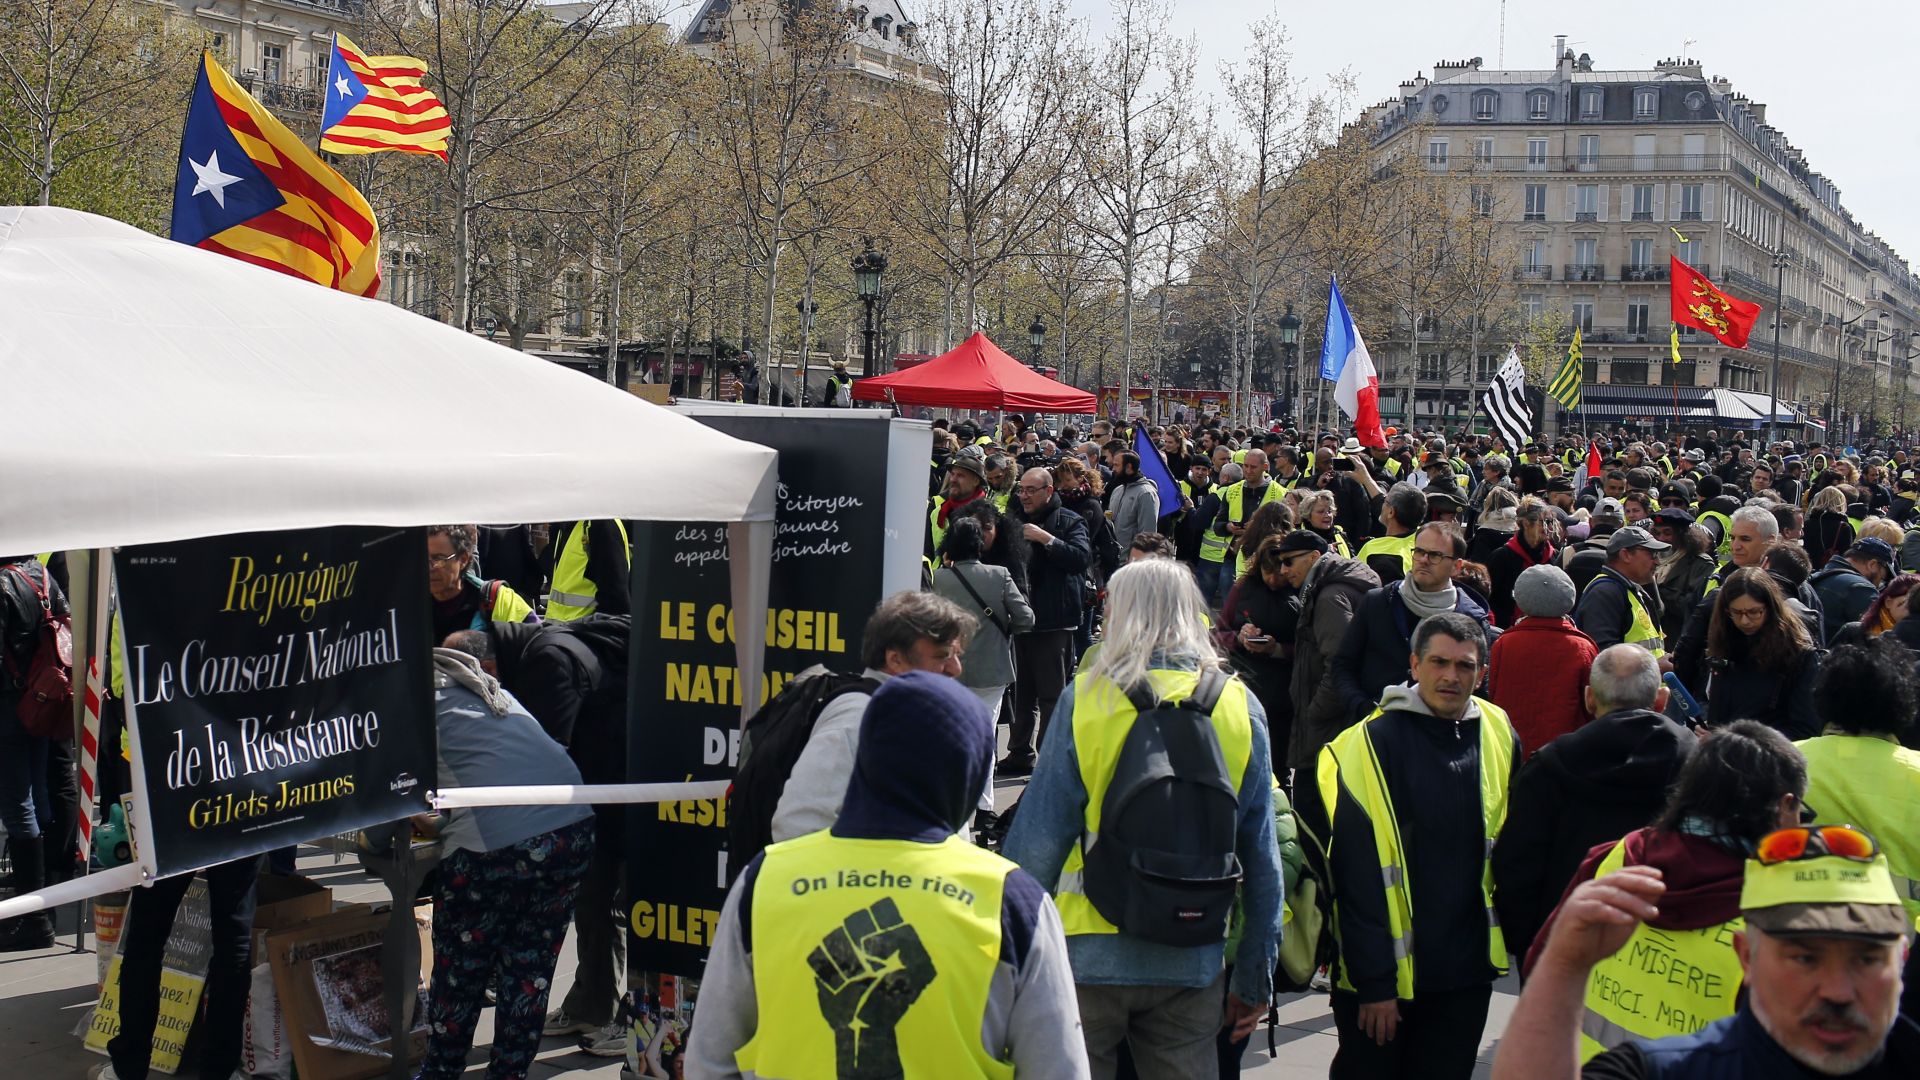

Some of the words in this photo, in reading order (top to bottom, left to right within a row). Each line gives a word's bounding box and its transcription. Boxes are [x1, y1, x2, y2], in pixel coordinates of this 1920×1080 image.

[786, 495, 863, 514] citoyen
[675, 525, 707, 541] des
[771, 519, 839, 539] jaunes
[770, 538, 851, 562] joindre
[220, 553, 358, 626] Rejoignez
[660, 601, 695, 641] LE
[133, 644, 174, 706] Le
[181, 633, 295, 698] Conseil
[297, 608, 402, 684] National
[167, 730, 201, 790] de
[206, 724, 236, 782] la
[237, 709, 380, 776] Résistance
[189, 793, 269, 829] Gilets
[274, 773, 355, 813] Jaunes
[791, 876, 827, 896] On
[838, 869, 912, 889] lâche
[922, 876, 975, 906] rien
[631, 900, 720, 947] GILET
[1629, 941, 1722, 998] MISERE
[98, 991, 113, 1011] la
[1656, 1000, 1708, 1034] MAN
[90, 1013, 121, 1037] Gile
[244, 1024, 256, 1072] Office
